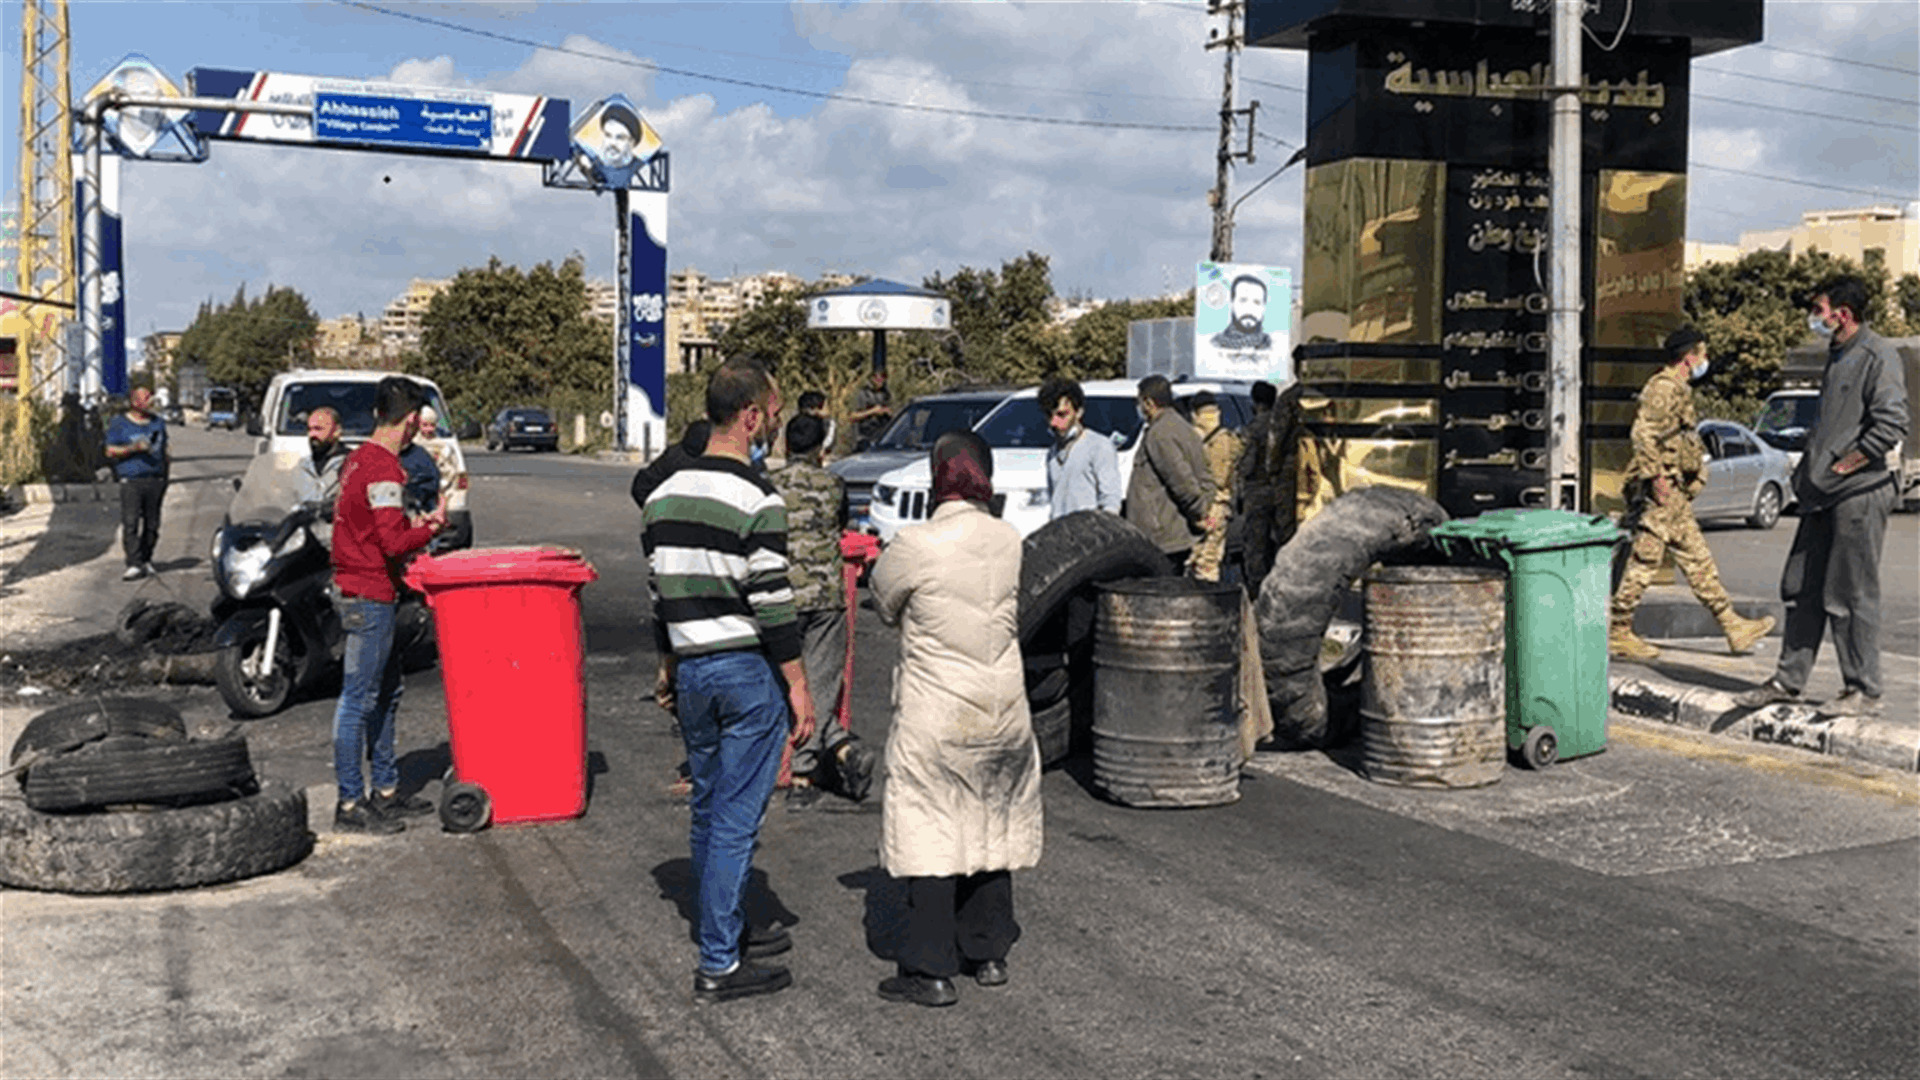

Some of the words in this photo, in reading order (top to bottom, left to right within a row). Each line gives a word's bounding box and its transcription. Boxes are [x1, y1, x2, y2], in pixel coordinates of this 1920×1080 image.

[1385, 51, 1553, 117] العباسية
[1580, 69, 1665, 125] بلدي
[319, 100, 400, 120] Abbassieh
[420, 103, 488, 125] العباسية
